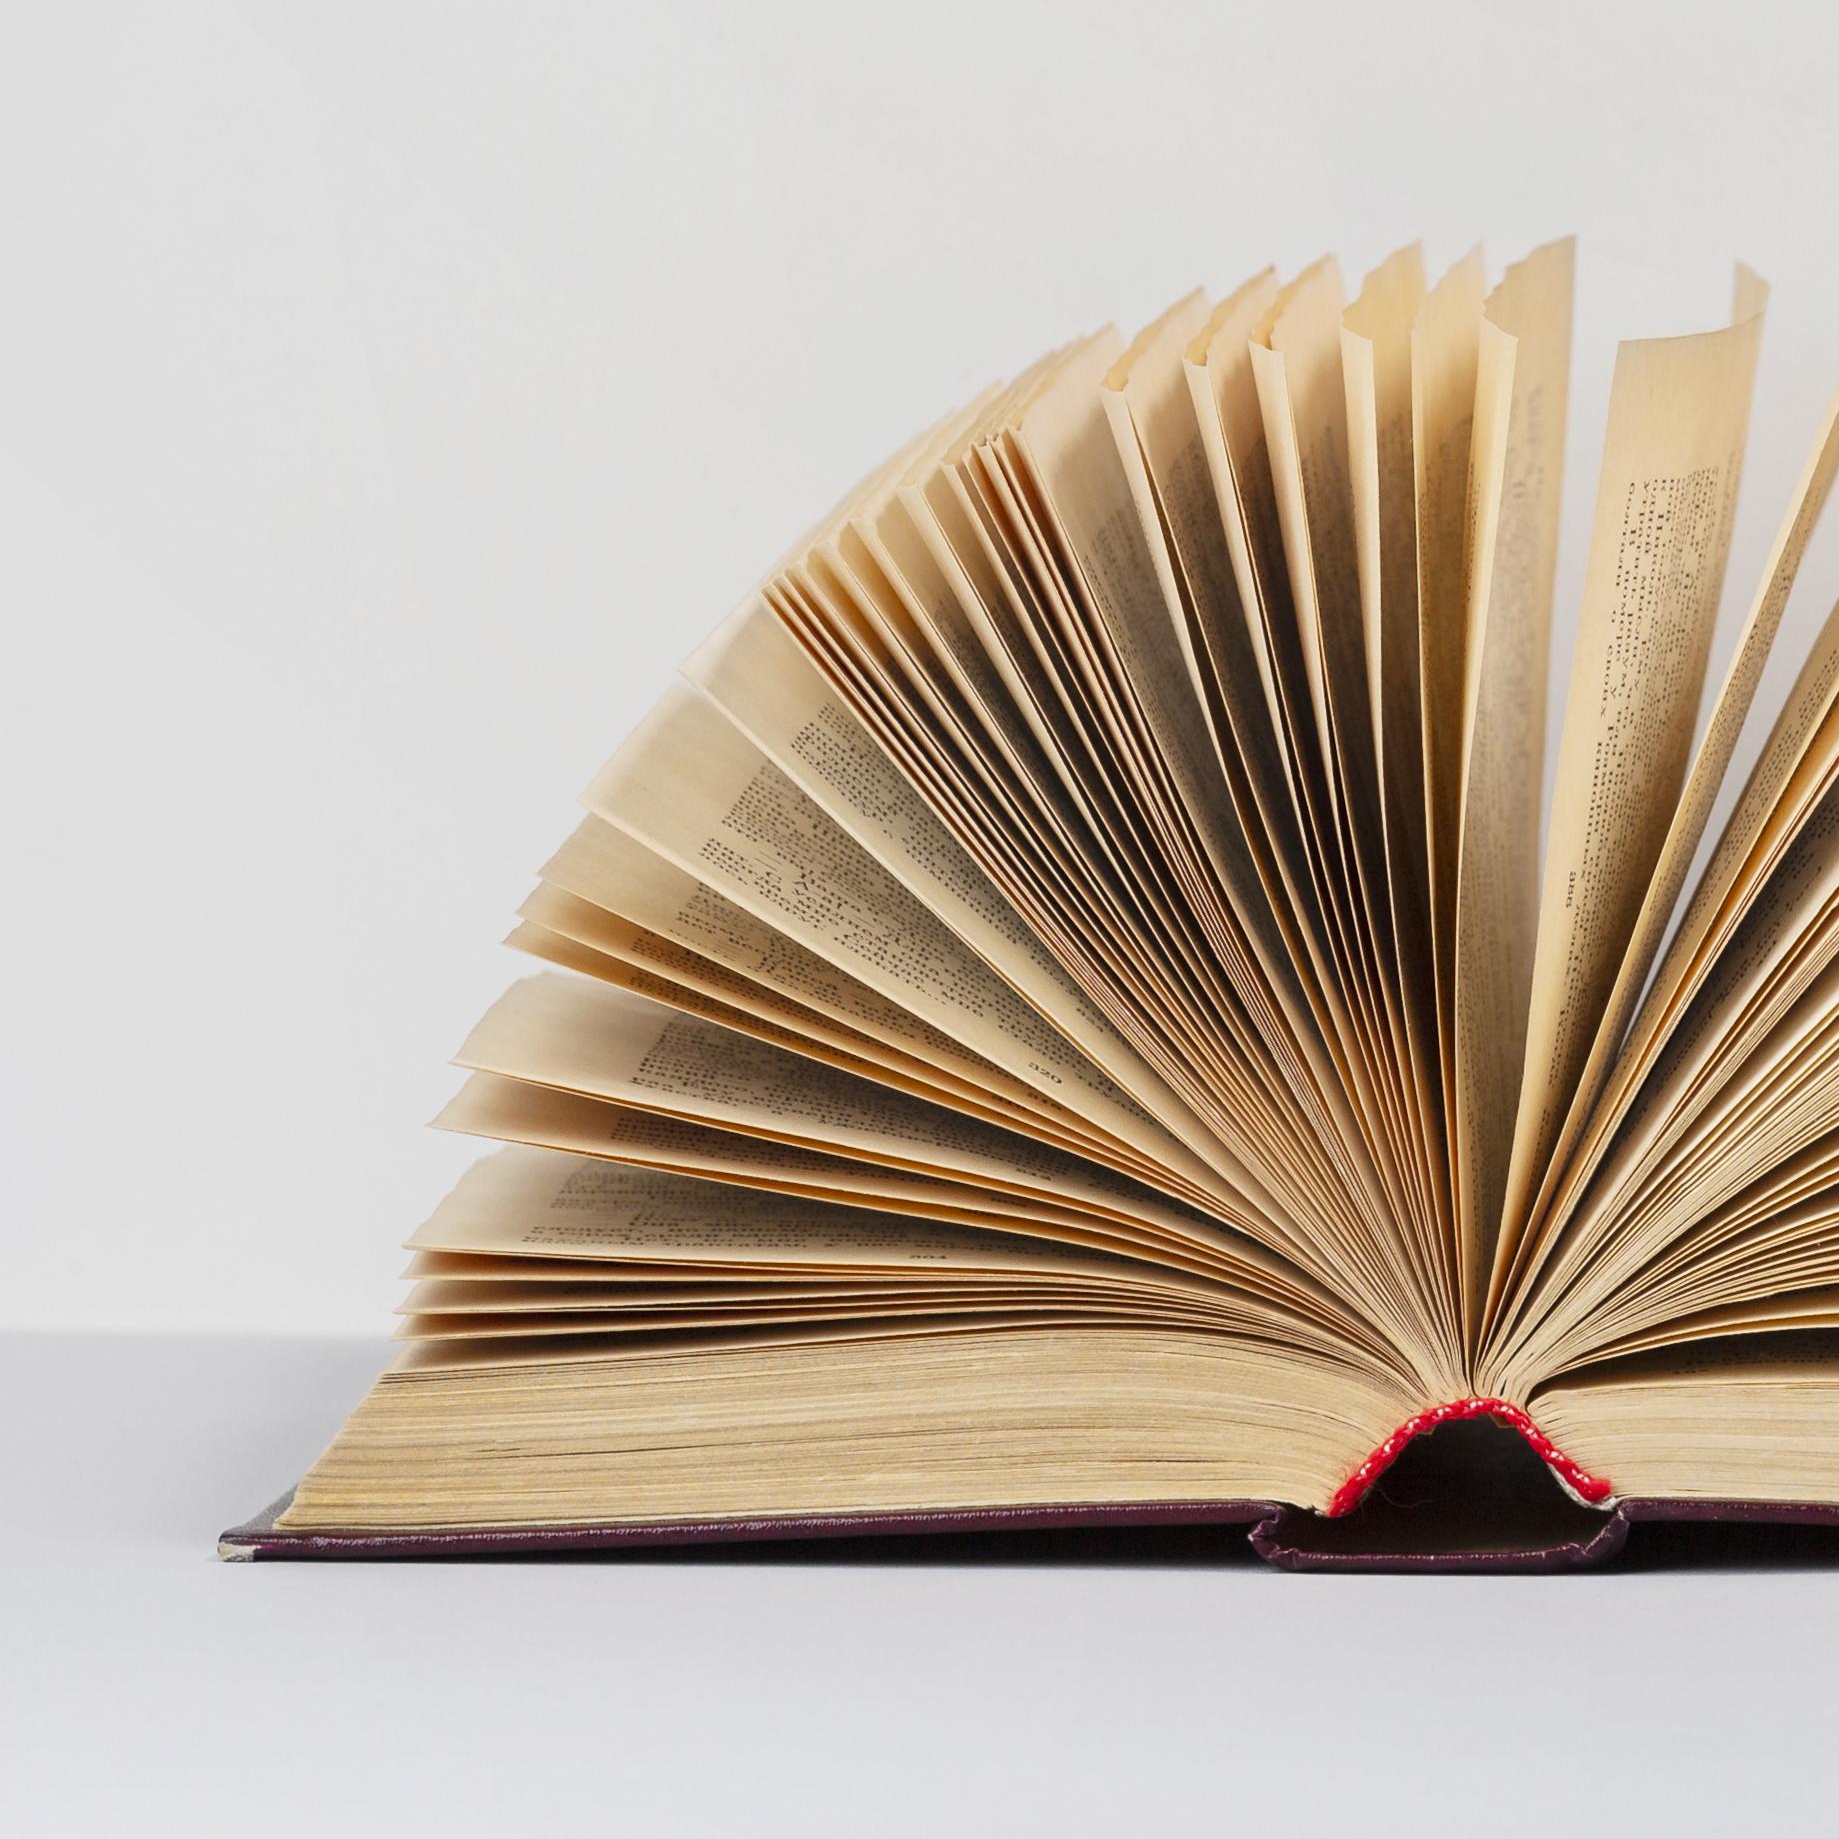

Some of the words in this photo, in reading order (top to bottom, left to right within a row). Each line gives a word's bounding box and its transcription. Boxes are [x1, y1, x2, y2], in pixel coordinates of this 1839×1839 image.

[1613, 480, 1635, 588] болтали
[1599, 644, 1613, 719] своих
[1026, 1060, 1064, 1086] 320
